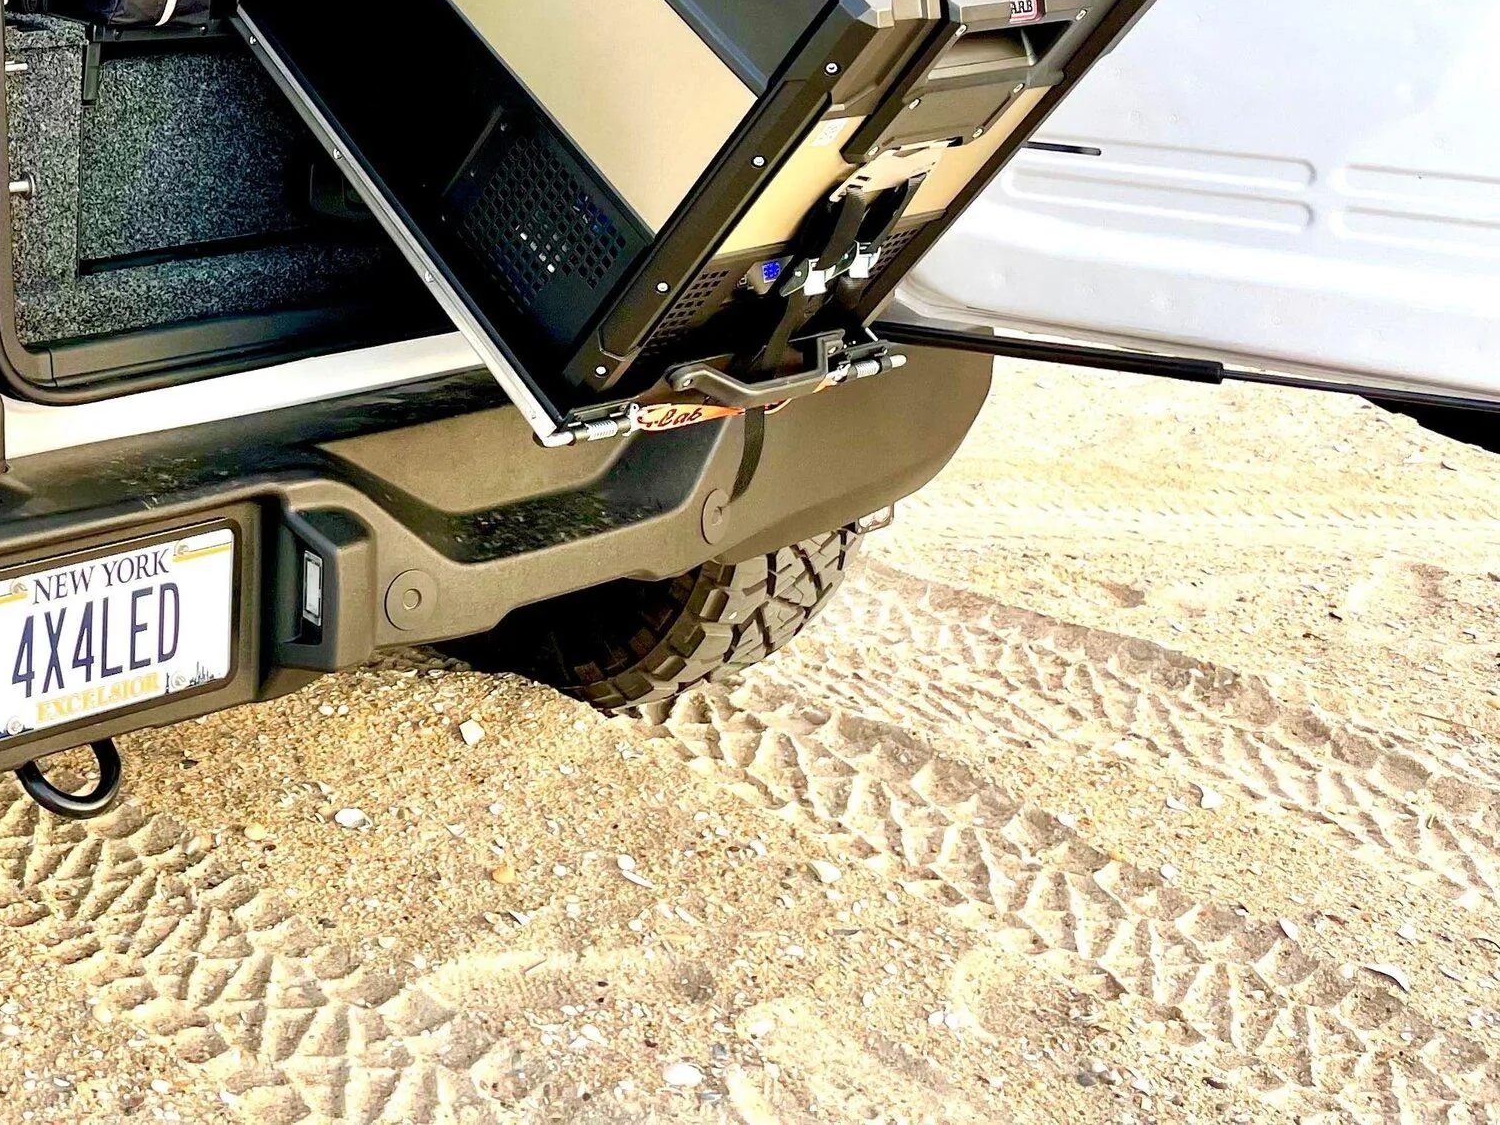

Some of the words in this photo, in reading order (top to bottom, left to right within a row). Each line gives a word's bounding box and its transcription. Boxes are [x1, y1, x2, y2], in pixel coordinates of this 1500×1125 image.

[1009, 0, 1033, 15] ARB
[31, 565, 97, 605] NEW
[101, 548, 170, 588] YORK
[11, 582, 180, 698] 4X4LED
[36, 672, 160, 723] EXCELSIOR
